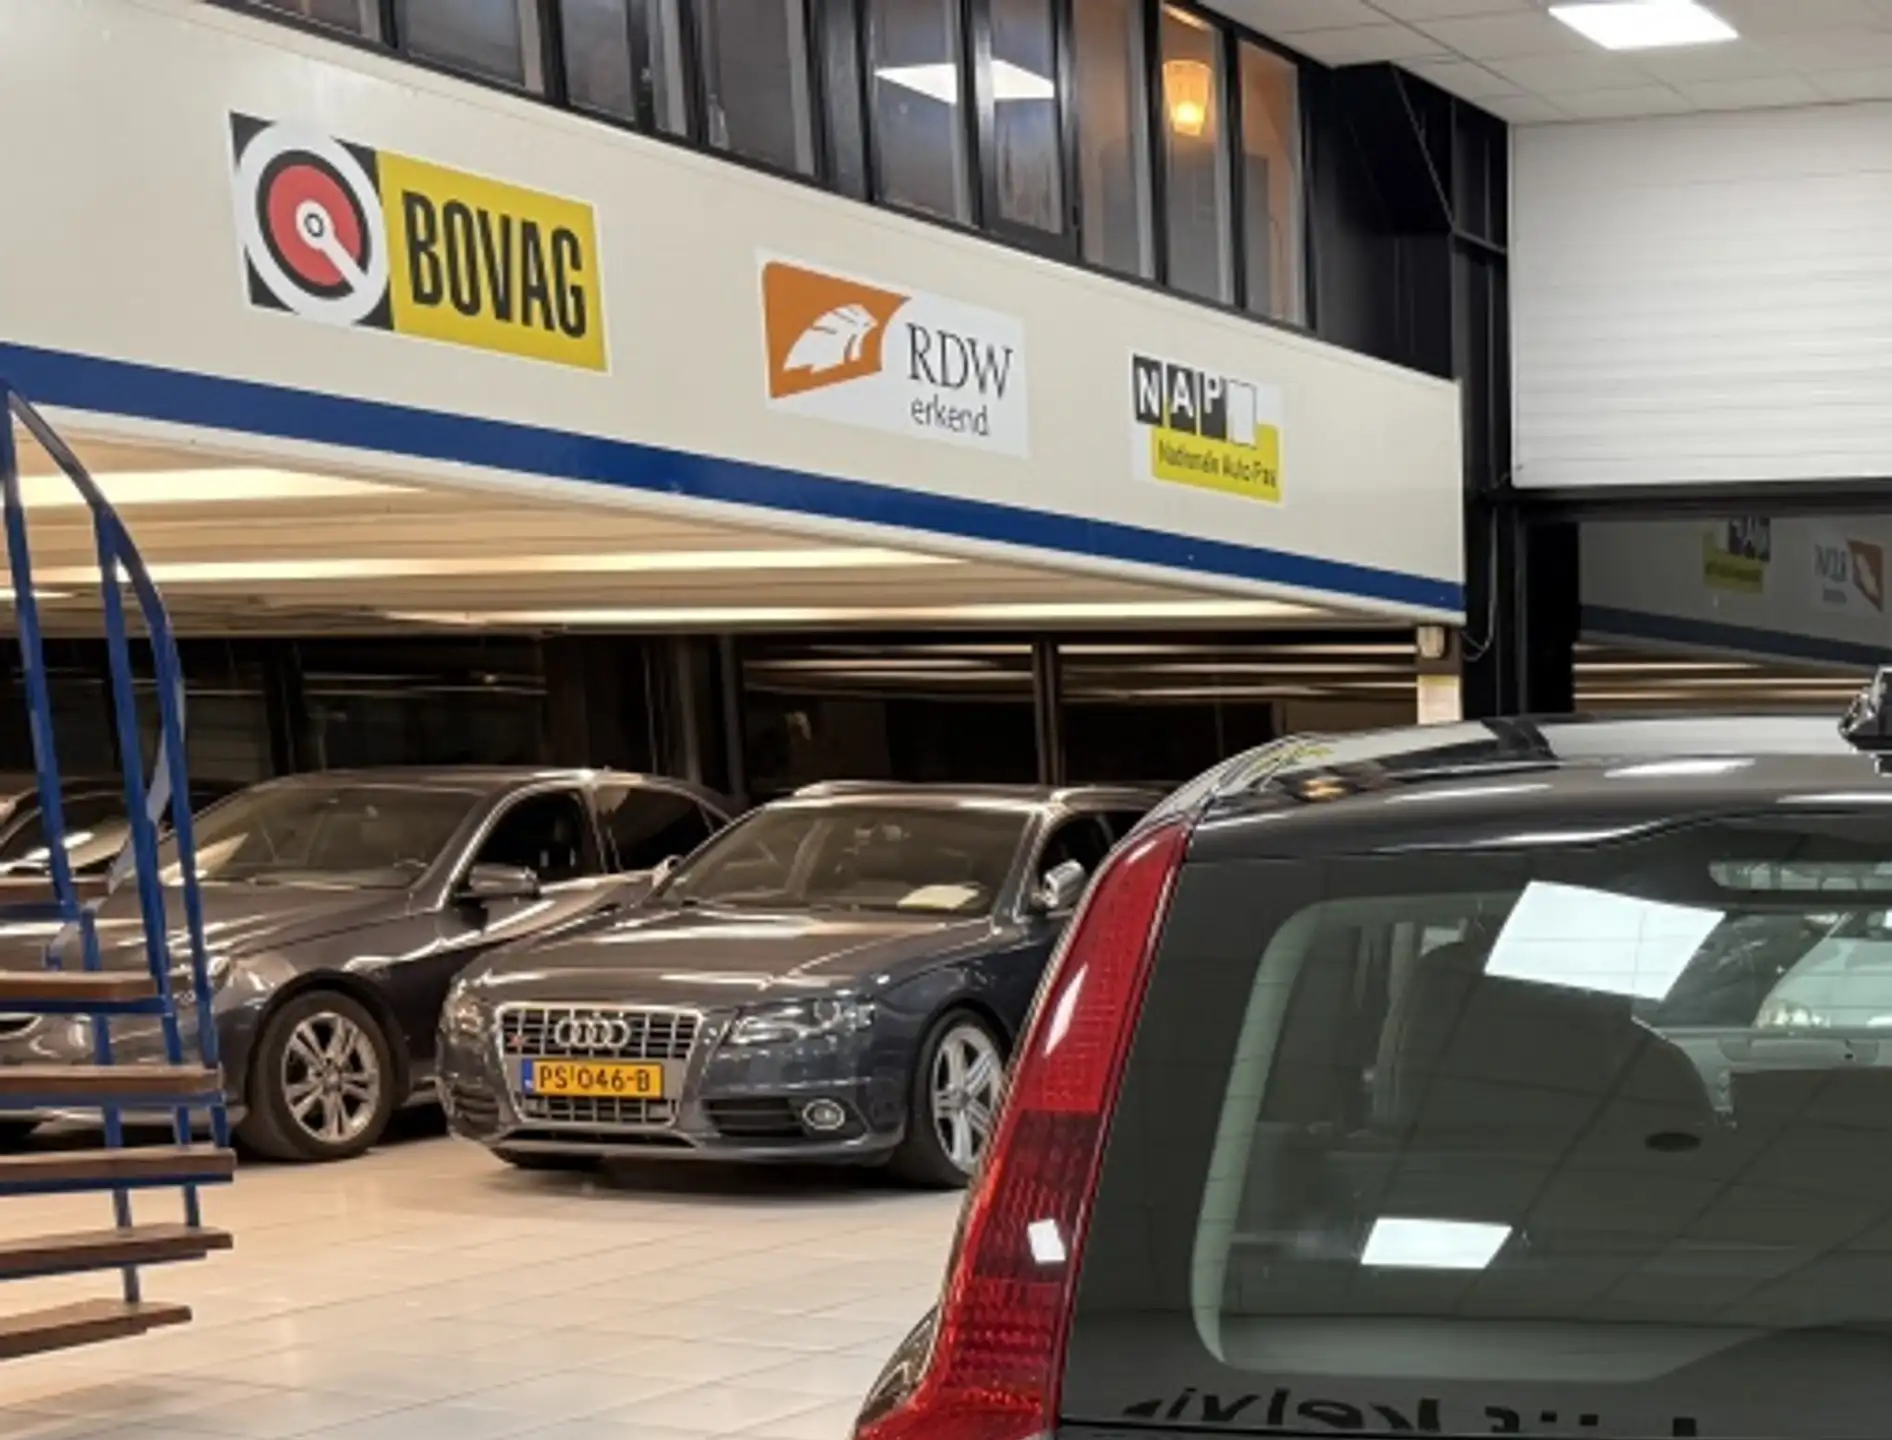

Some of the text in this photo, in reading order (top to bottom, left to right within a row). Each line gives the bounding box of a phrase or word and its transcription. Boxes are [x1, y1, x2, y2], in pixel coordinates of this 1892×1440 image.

[402, 189, 587, 338] BOVAG
[906, 322, 1014, 401] RDW
[1138, 366, 1223, 419] NAP
[910, 393, 989, 437] erkend
